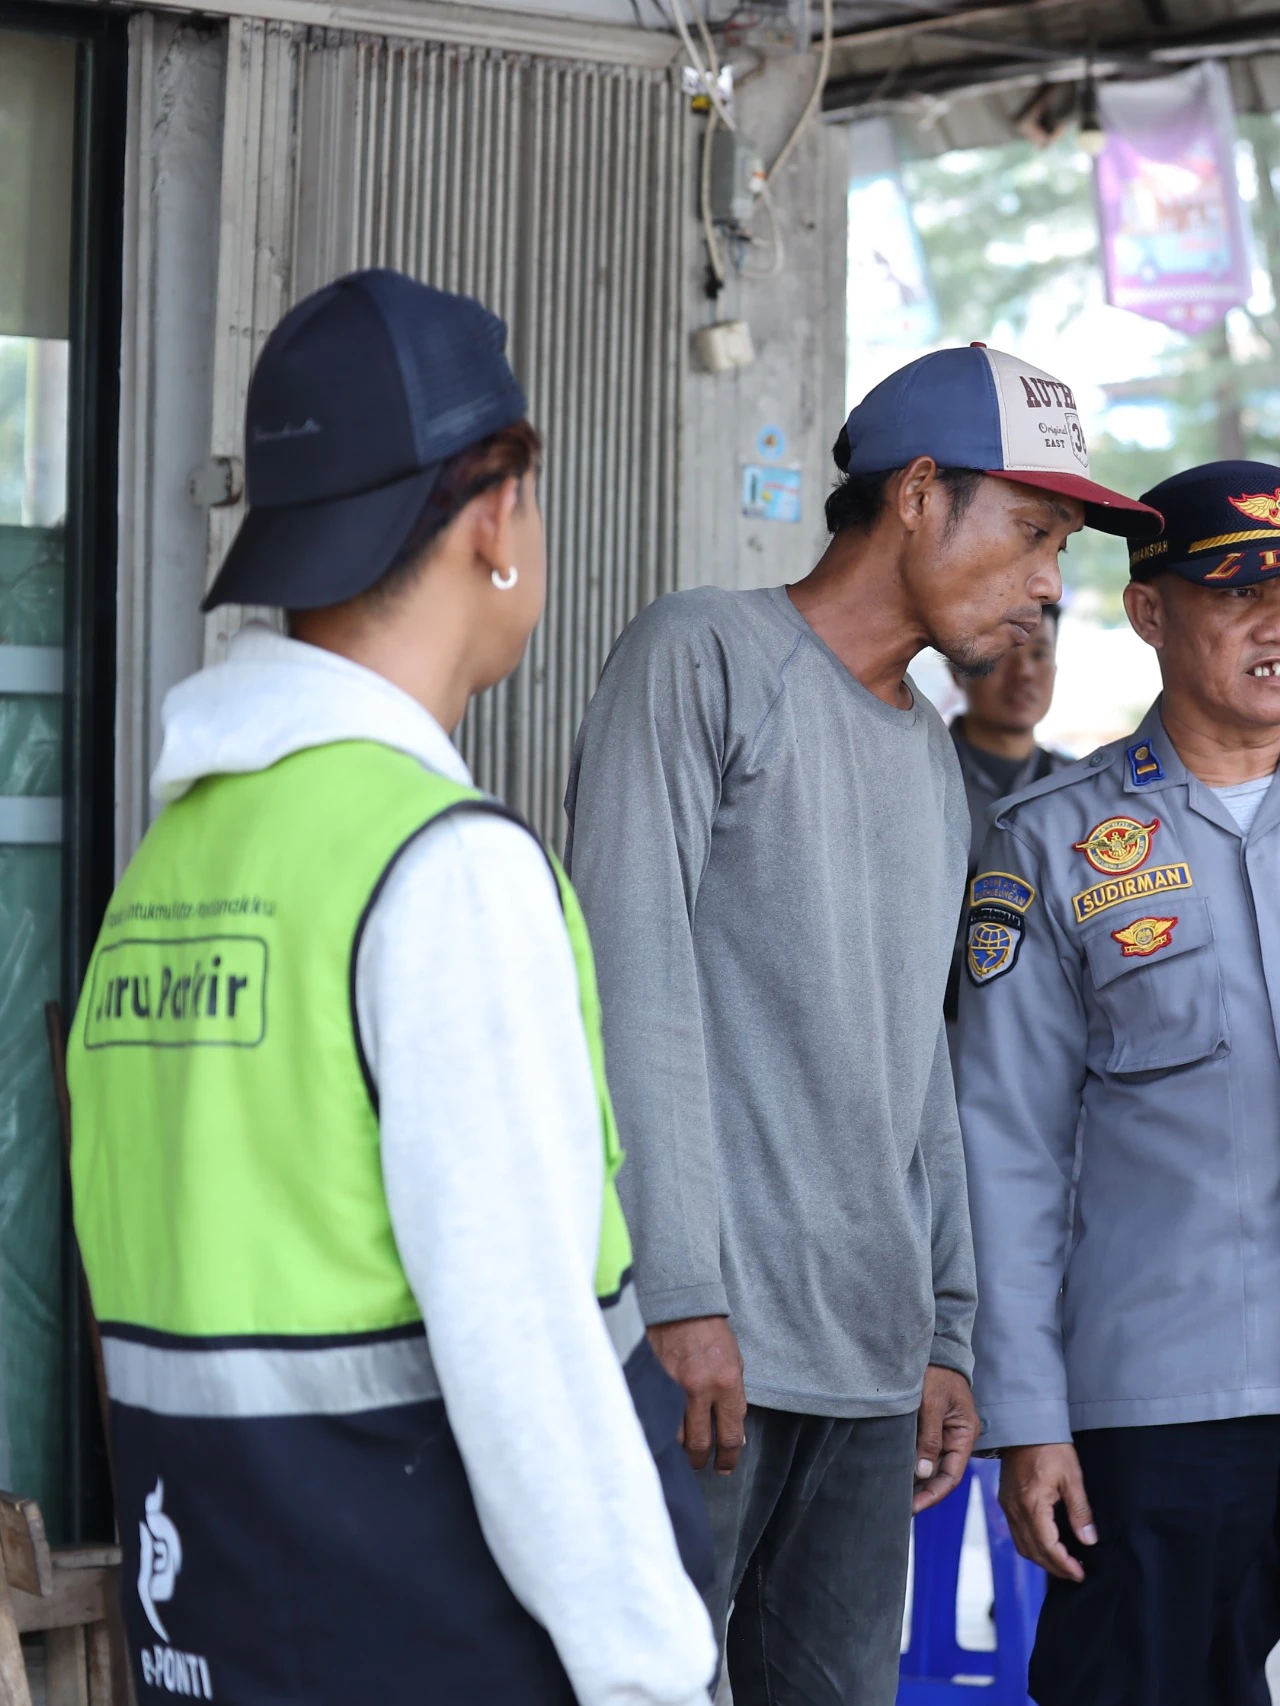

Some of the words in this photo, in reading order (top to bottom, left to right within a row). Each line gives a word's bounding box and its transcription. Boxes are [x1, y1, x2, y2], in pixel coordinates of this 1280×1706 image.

[1019, 375, 1077, 410] AUTH
[1038, 422, 1068, 436] Original
[1045, 438, 1065, 448] EAST
[1083, 868, 1182, 913] SUDIRMAN
